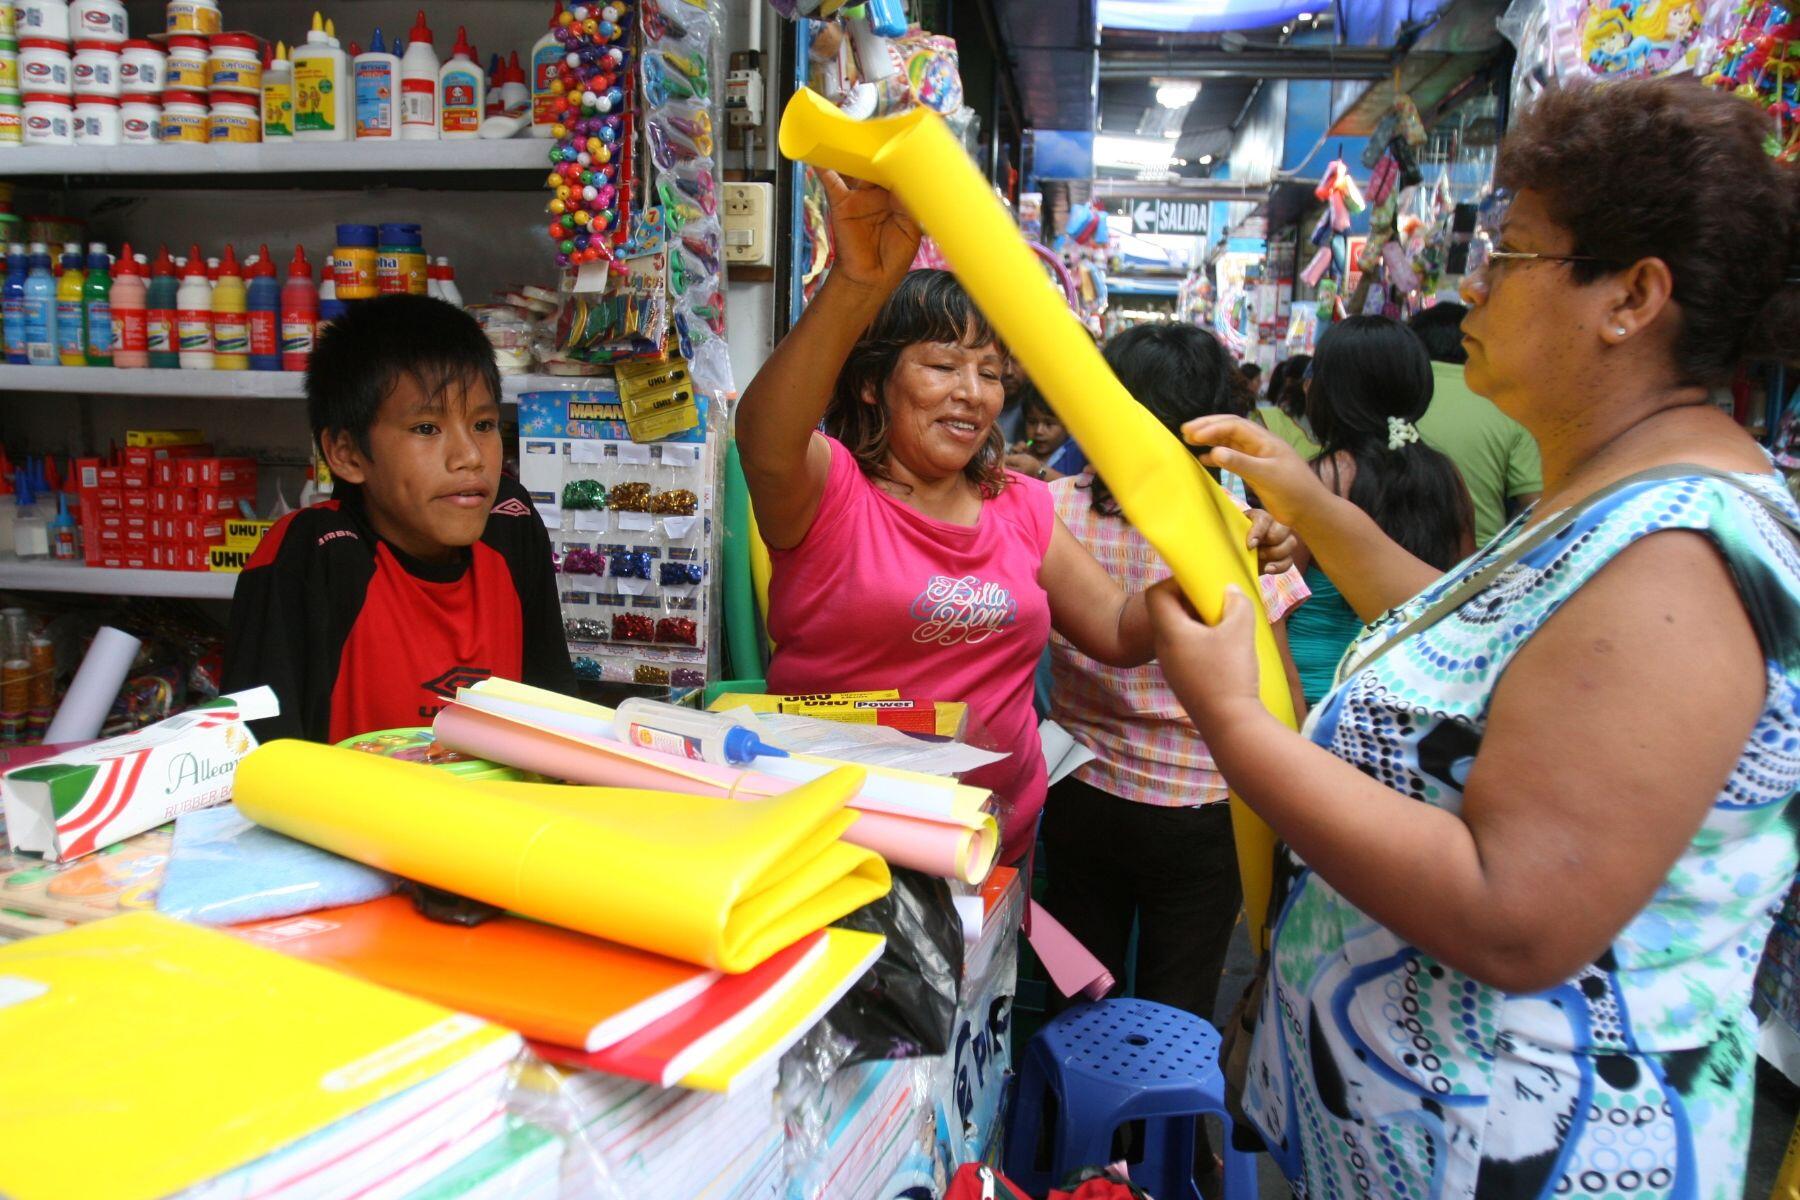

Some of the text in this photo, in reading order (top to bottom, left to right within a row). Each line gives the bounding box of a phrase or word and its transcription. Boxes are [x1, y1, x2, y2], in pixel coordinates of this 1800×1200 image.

[1159, 202, 1207, 232] SALIDA
[647, 376, 667, 387] UHU
[569, 402, 626, 419] MARAN
[652, 399, 672, 409] UHU
[229, 524, 257, 536] UHU
[165, 752, 240, 795] Allean
[163, 788, 219, 819] RUBBER
